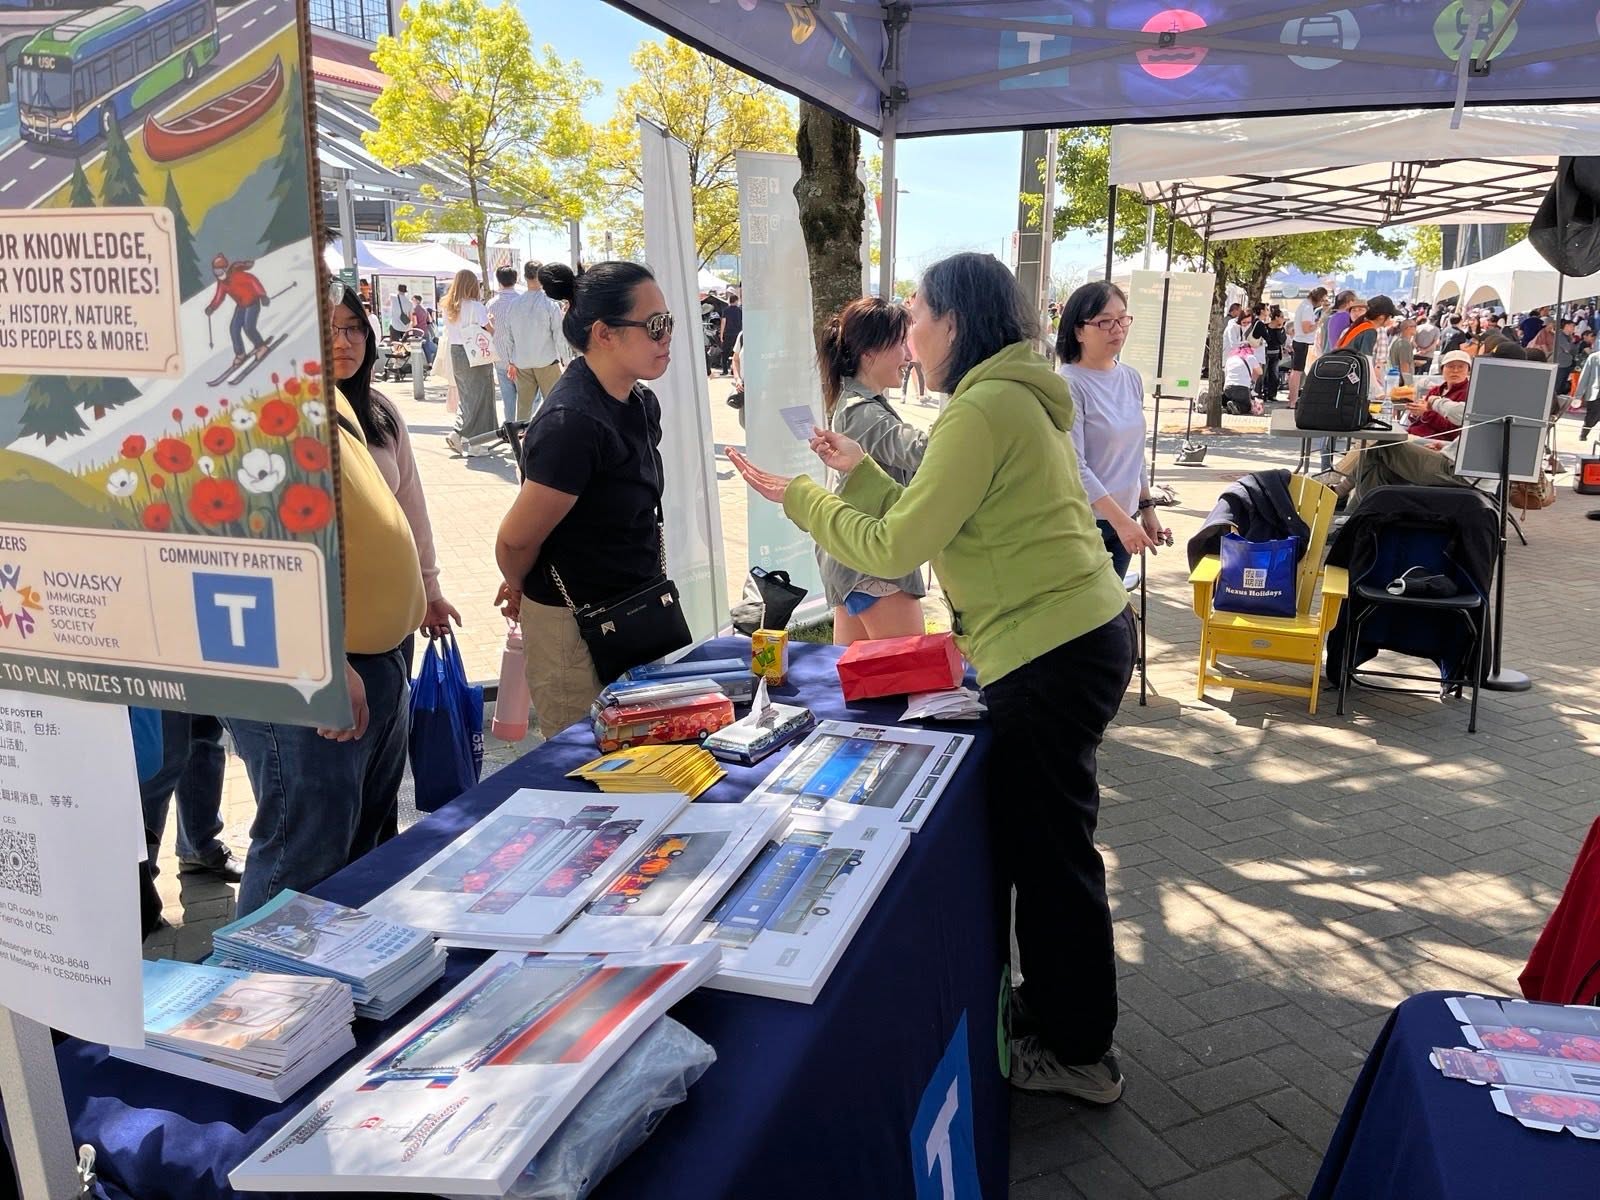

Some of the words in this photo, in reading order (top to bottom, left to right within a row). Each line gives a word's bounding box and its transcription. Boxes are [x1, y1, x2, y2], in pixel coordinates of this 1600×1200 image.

[23, 232, 152, 264] KNOWLEDGE,
[13, 267, 65, 294] YOUR
[70, 267, 160, 294] STORIES!
[9, 304, 72, 326] HISTORY,
[75, 307, 138, 328] NATURE,
[21, 329, 83, 350] PEOPLES
[87, 331, 98, 350] &
[101, 331, 150, 351] MORE!
[159, 546, 239, 569] COMMUNITY
[243, 552, 304, 573] PARTNER
[43, 570, 123, 594] NOVASKY
[1225, 586, 1248, 596] Nexus
[1248, 589, 1283, 598] Holidays
[46, 591, 108, 607] IMMIGRANT
[48, 604, 97, 620] SERVICES
[213, 592, 257, 648] T
[51, 618, 95, 634] SOCIETY
[54, 632, 121, 650] VANCOUVER
[3, 663, 23, 682] TO
[24, 666, 66, 690] PLAY,
[67, 671, 121, 695] PRIZES
[124, 677, 146, 697] TO
[148, 680, 188, 701] WIN!
[0, 706, 10, 716] DE
[10, 708, 43, 718] POSTER
[2, 815, 17, 825] CES
[7, 902, 19, 912] QR
[19, 907, 35, 917] code
[36, 911, 44, 919] to
[45, 912, 59, 922] join
[25, 920, 33, 929] of
